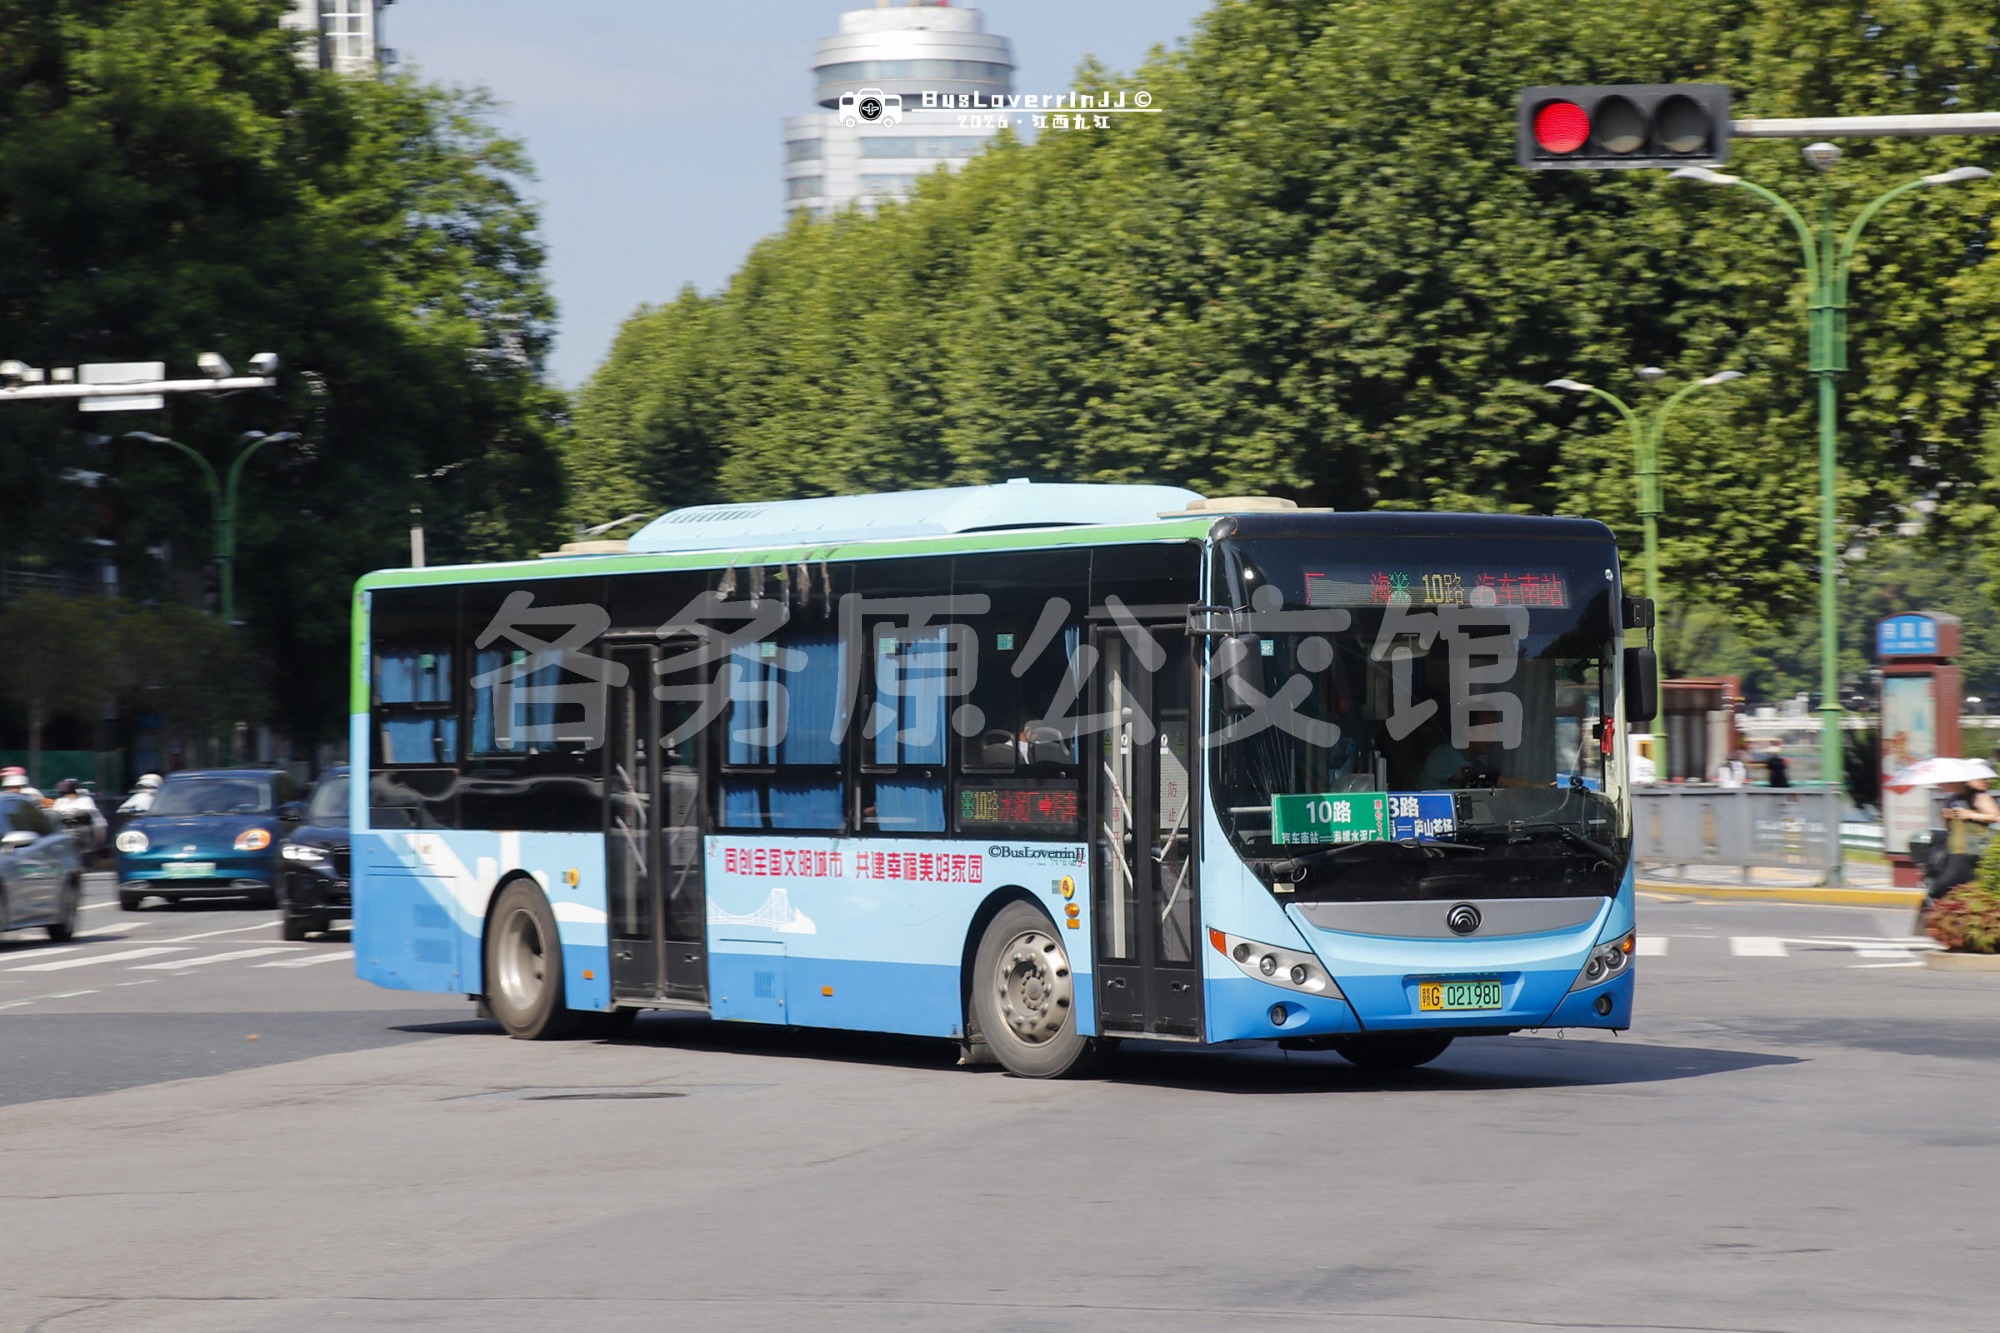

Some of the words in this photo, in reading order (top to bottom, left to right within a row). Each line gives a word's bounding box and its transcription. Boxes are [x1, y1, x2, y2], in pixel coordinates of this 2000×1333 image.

[1421, 572, 1464, 605] 10路
[1475, 572, 1564, 606] 汽车南站
[1306, 800, 1352, 824] 10路
[725, 848, 843, 878] 同创全国文明城市
[856, 851, 983, 884] 共建幸福美好家园
[1447, 984, 1500, 1006] 02198D
